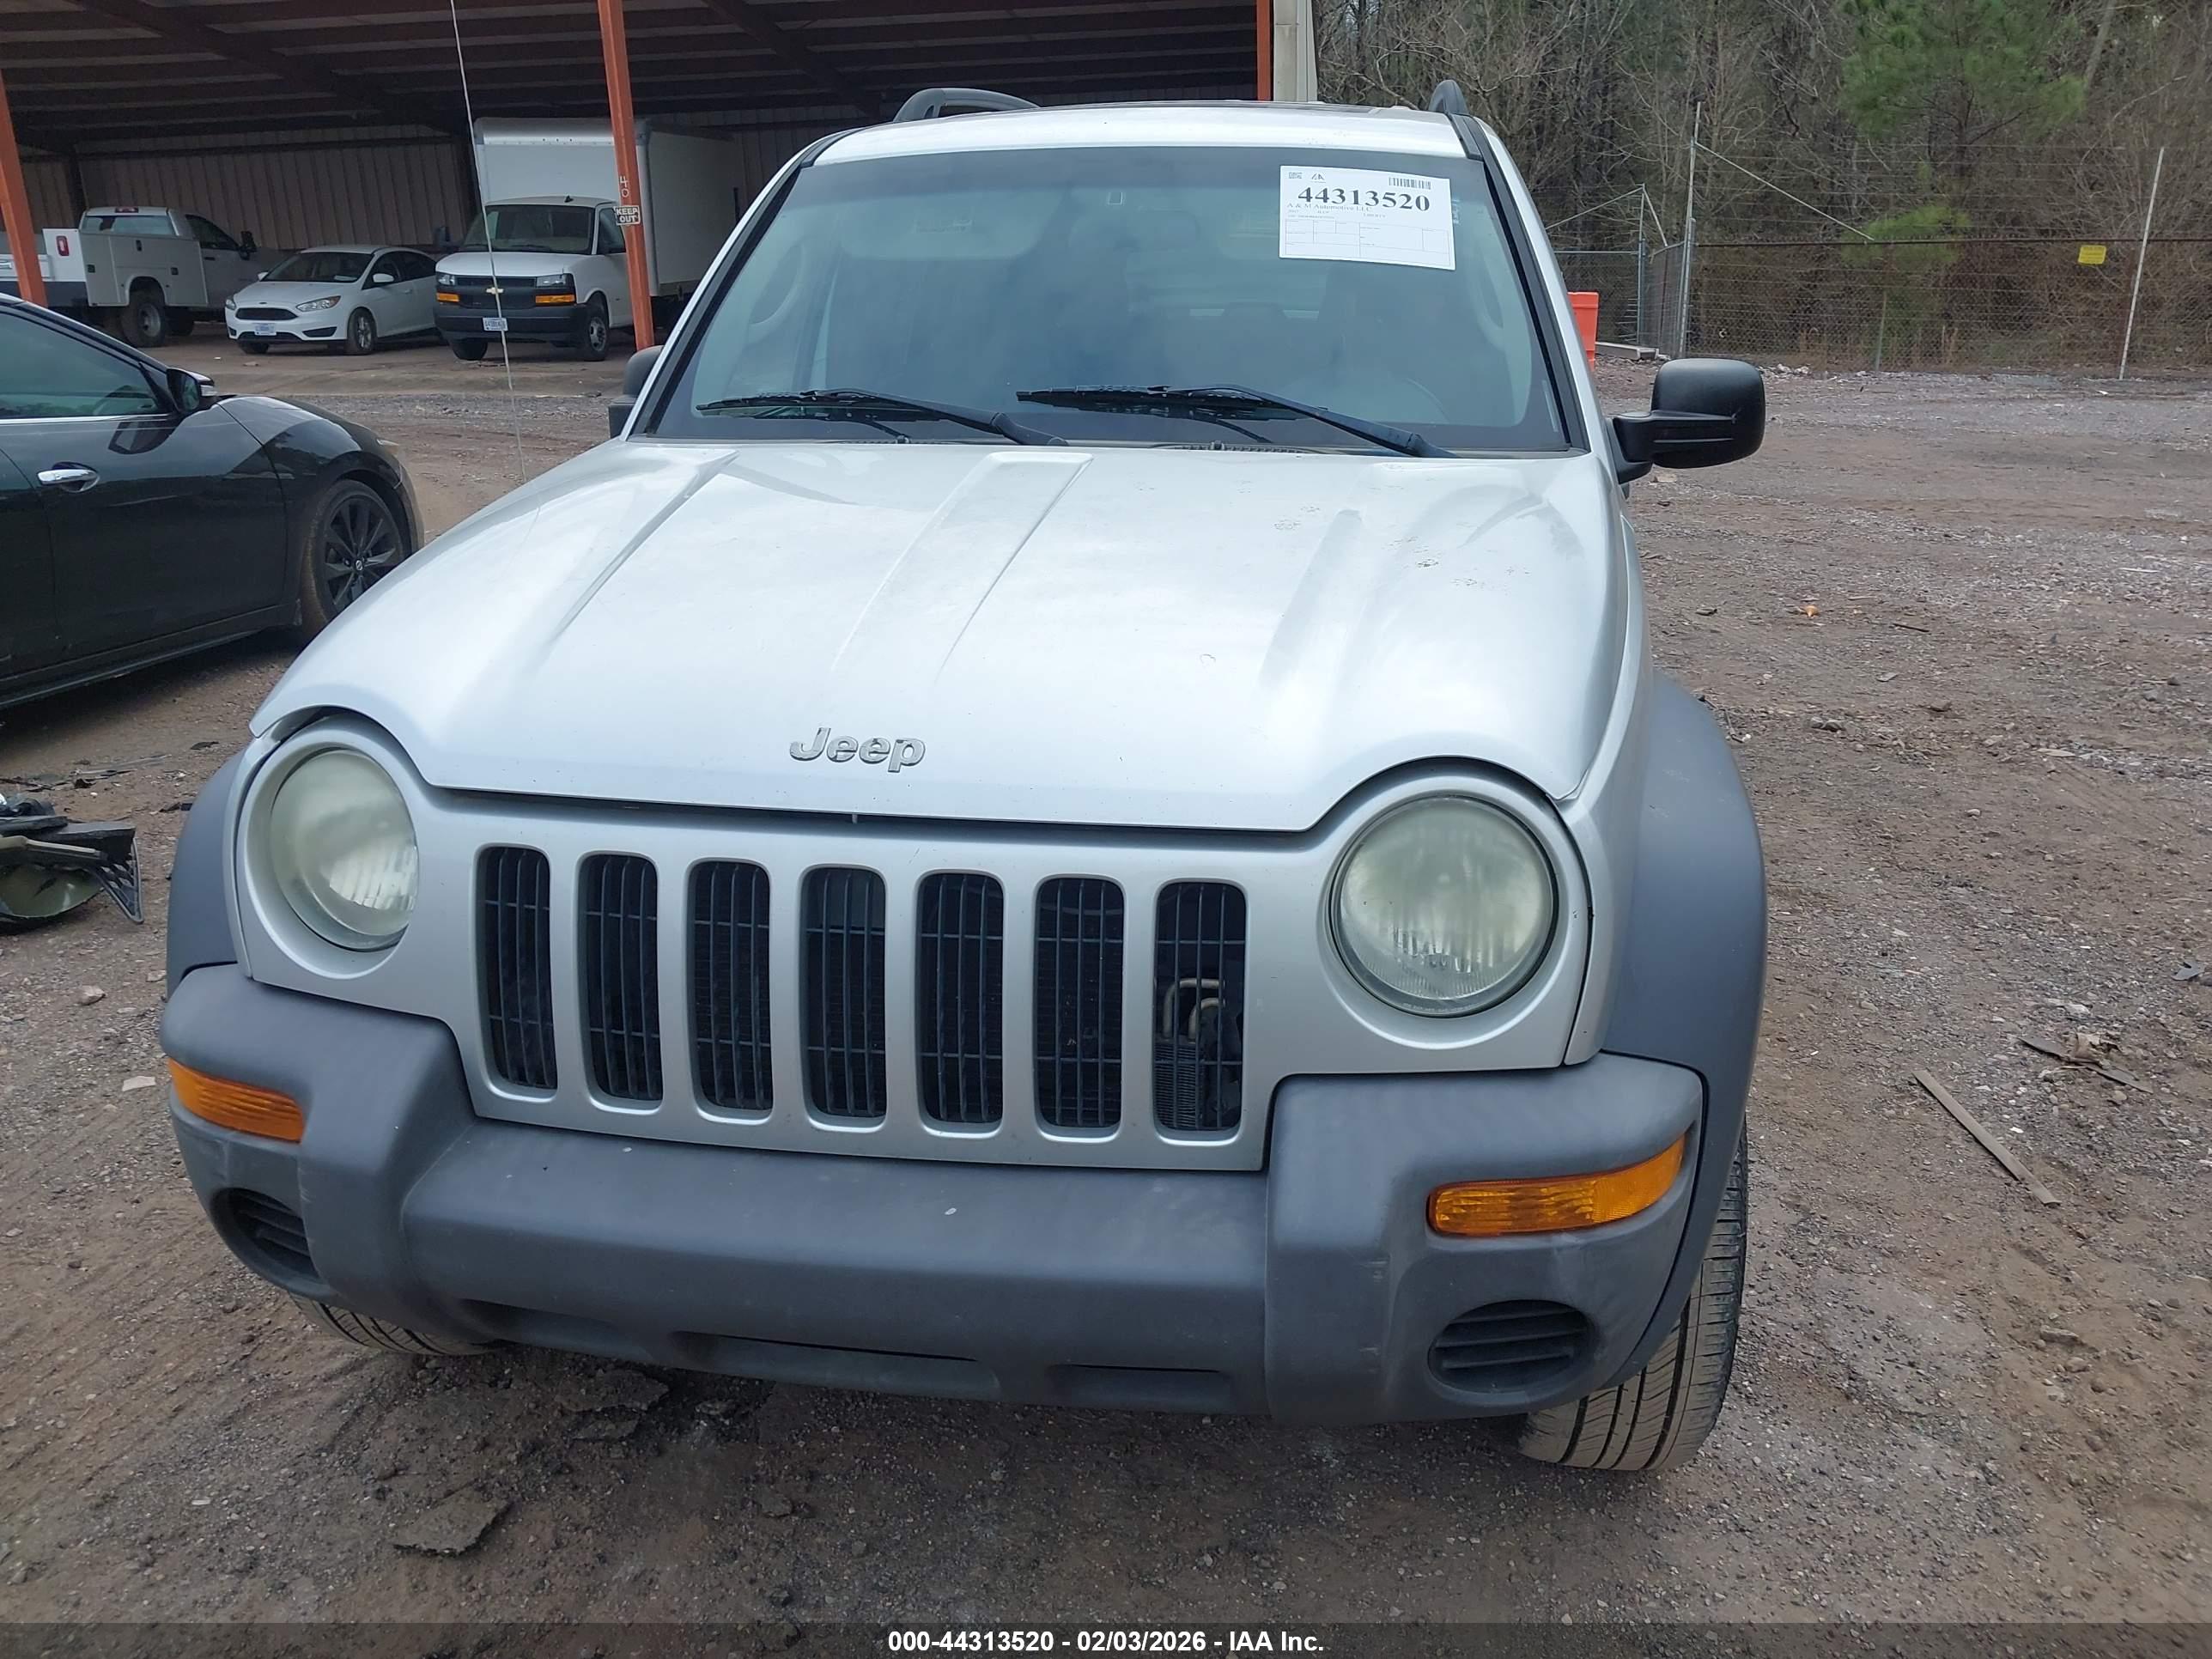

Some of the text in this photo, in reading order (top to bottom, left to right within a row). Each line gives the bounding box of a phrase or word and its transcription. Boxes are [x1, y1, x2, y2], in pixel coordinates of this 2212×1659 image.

[1297, 186, 1431, 212] 44313520
[616, 207, 638, 216] KEEP
[619, 215, 638, 223] OUT
[789, 727, 927, 773] Jeep
